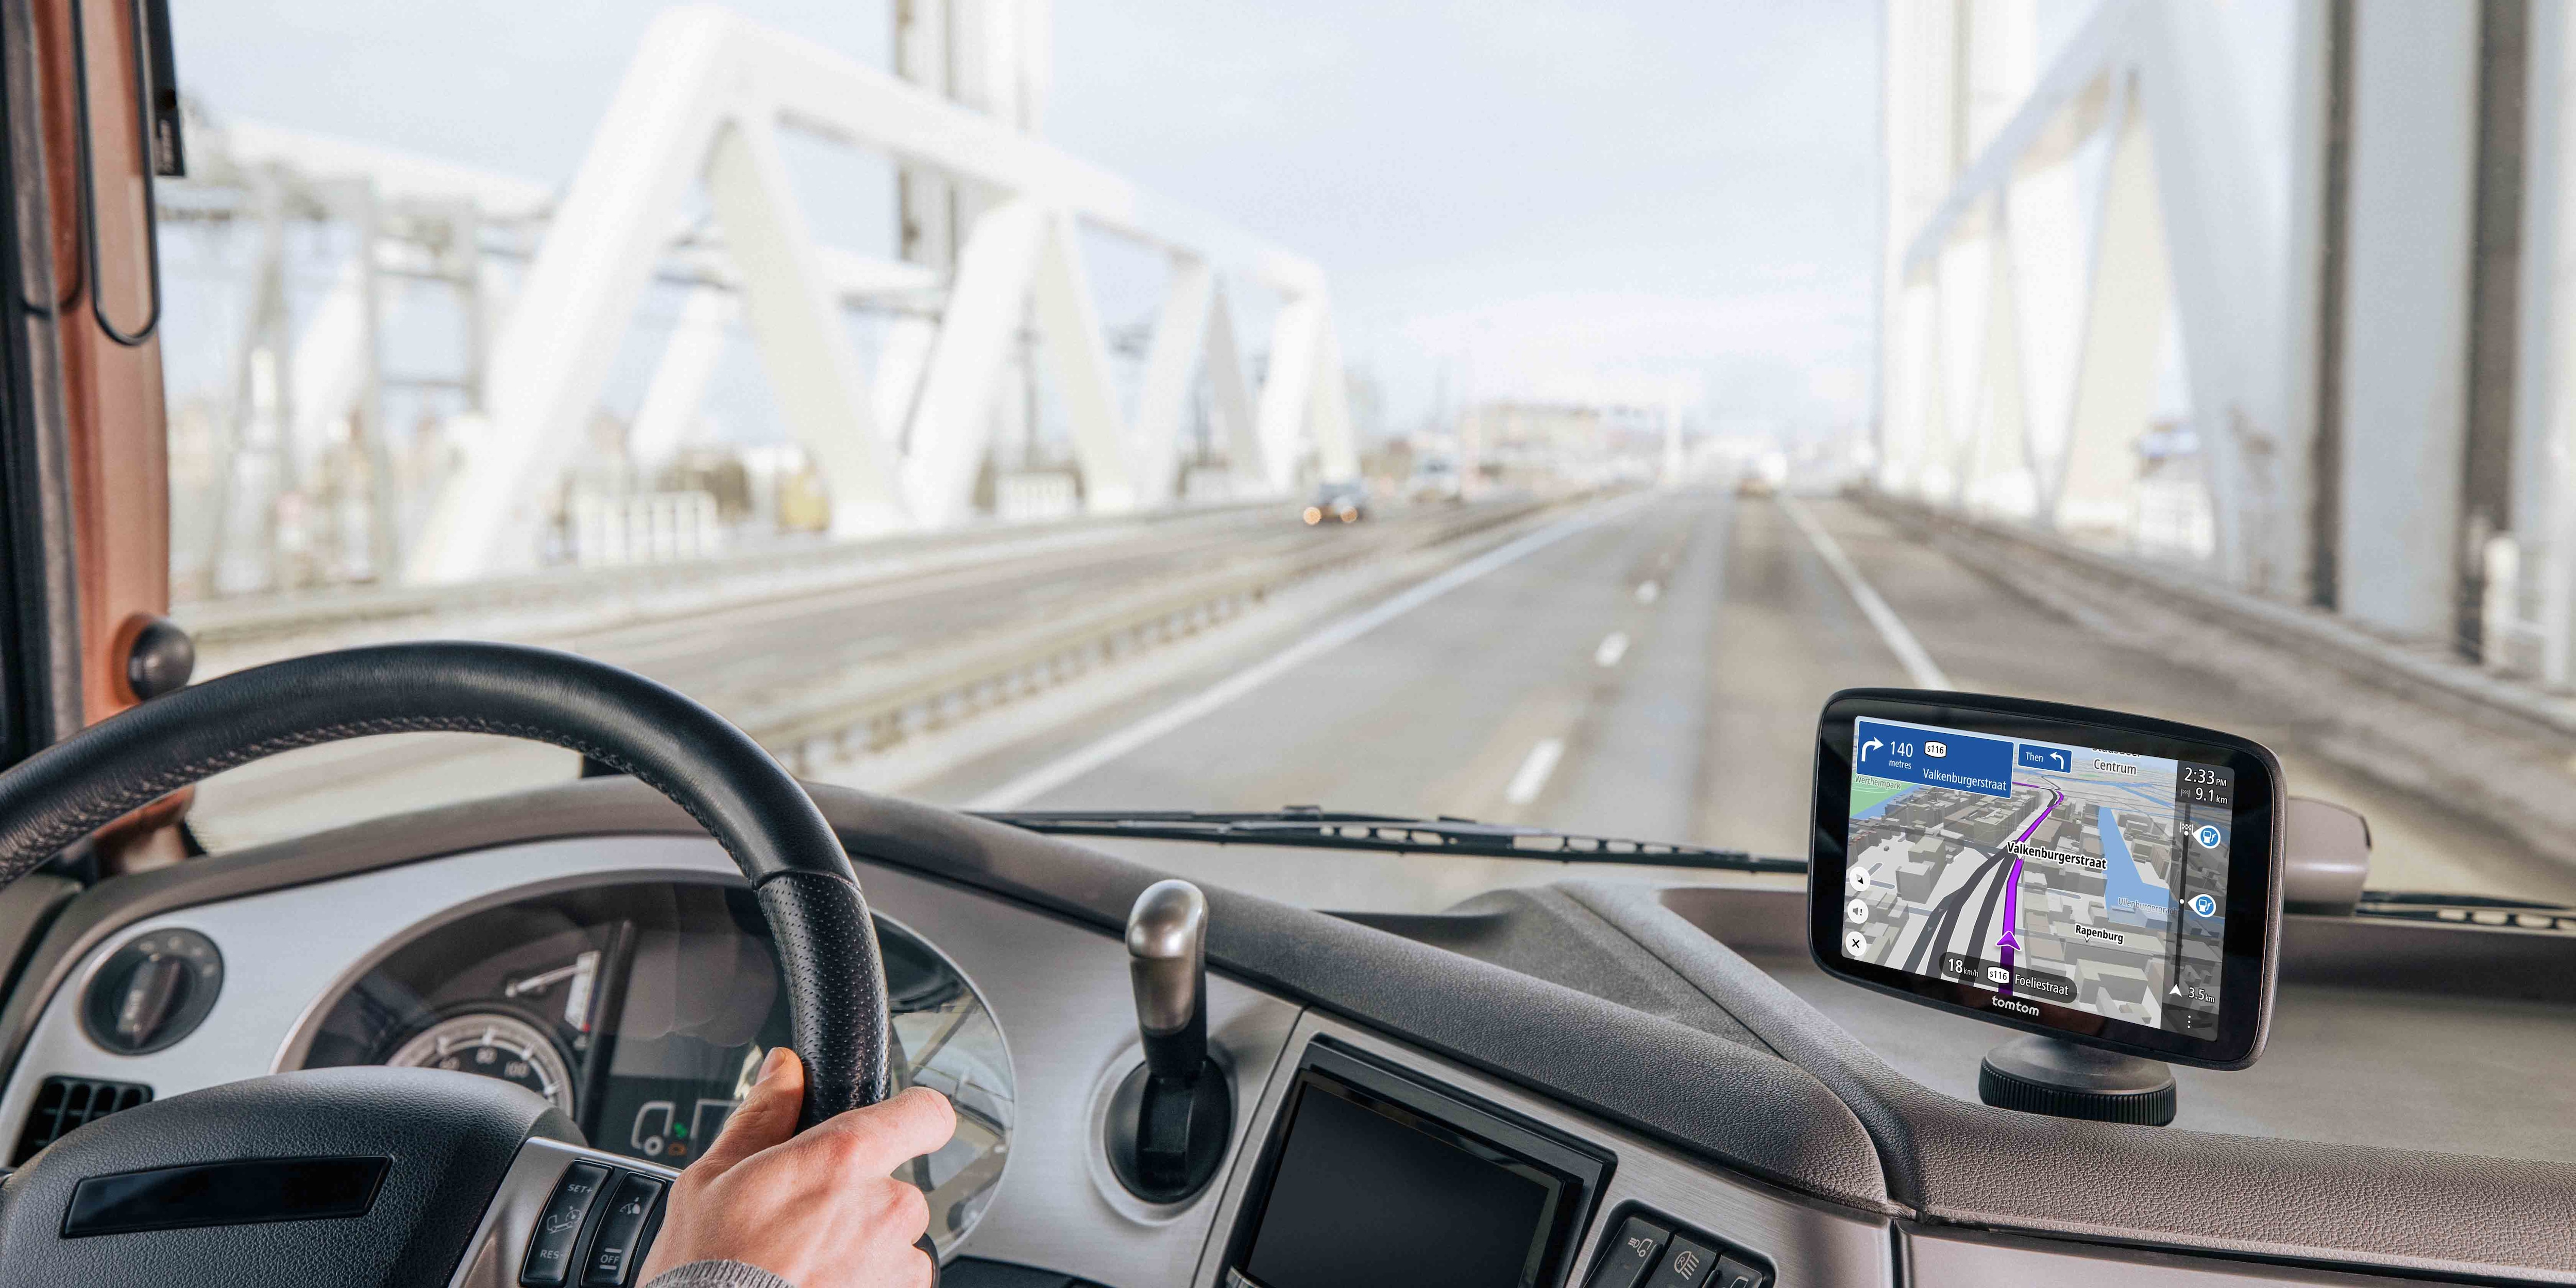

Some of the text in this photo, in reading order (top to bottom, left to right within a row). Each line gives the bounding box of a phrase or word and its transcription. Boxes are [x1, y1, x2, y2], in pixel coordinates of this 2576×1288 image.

[1890, 741, 1913, 758] 140
[1927, 745, 1944, 754] s116
[2025, 752, 2043, 762] Then
[1889, 760, 1911, 769] metres
[2094, 759, 2137, 775] Centrum
[1855, 775, 1901, 790] Wertheimpark
[1923, 768, 2007, 791] Valkenburgerstraat
[2184, 767, 2227, 787] 2:33 PM
[2195, 787, 2228, 804] 9.1 km
[2007, 842, 2107, 869] Valkenburgerstraat
[2075, 924, 2124, 944] Rapenburg
[1948, 958, 1979, 978] 18 km/h
[1989, 971, 2069, 996] s116 Foeliestraat
[2188, 987, 2215, 1003] 3.5 km
[1992, 995, 2039, 1016] tomtom
[568, 1184, 592, 1193] SET+
[600, 1254, 619, 1264] OFF
